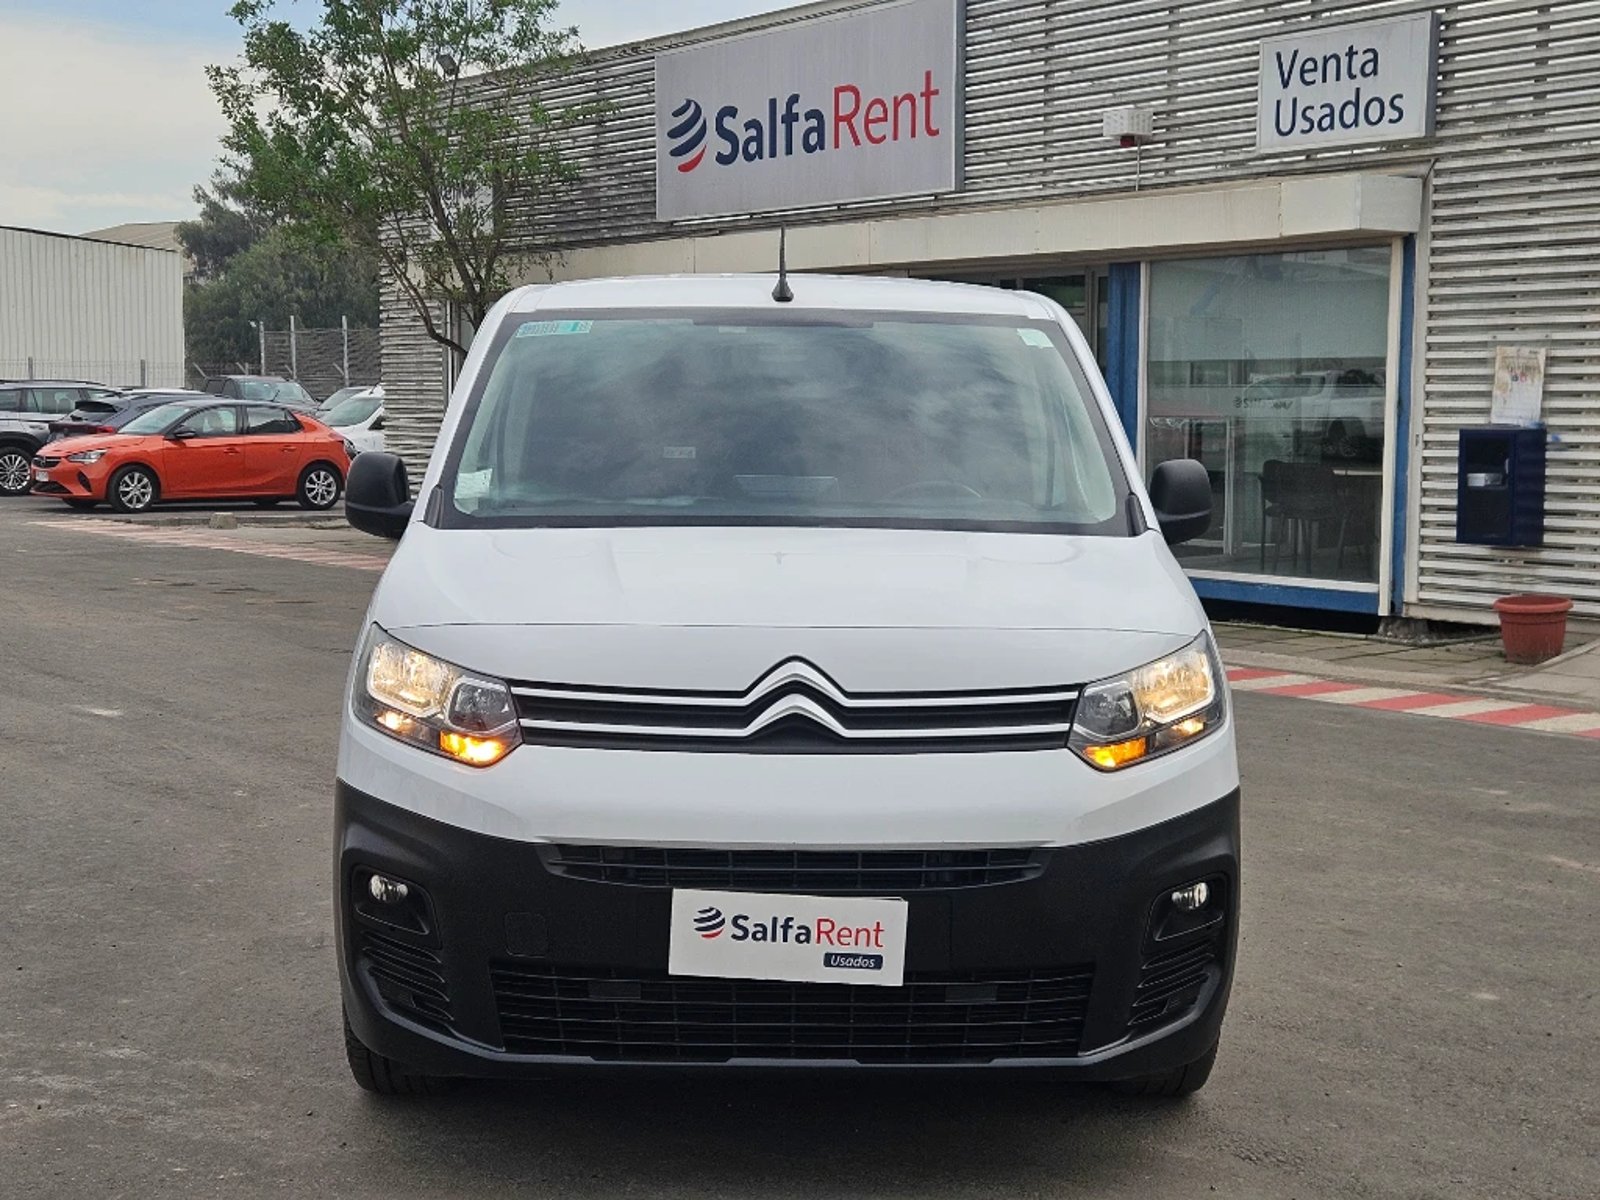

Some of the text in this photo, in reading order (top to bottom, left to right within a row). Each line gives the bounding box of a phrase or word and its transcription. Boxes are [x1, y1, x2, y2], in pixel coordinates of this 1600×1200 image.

[1275, 44, 1379, 90] Venta
[715, 70, 940, 166] SalfaRent
[1274, 87, 1404, 137] Usados
[730, 914, 885, 948] SalfaRent
[830, 954, 876, 968] Usados
